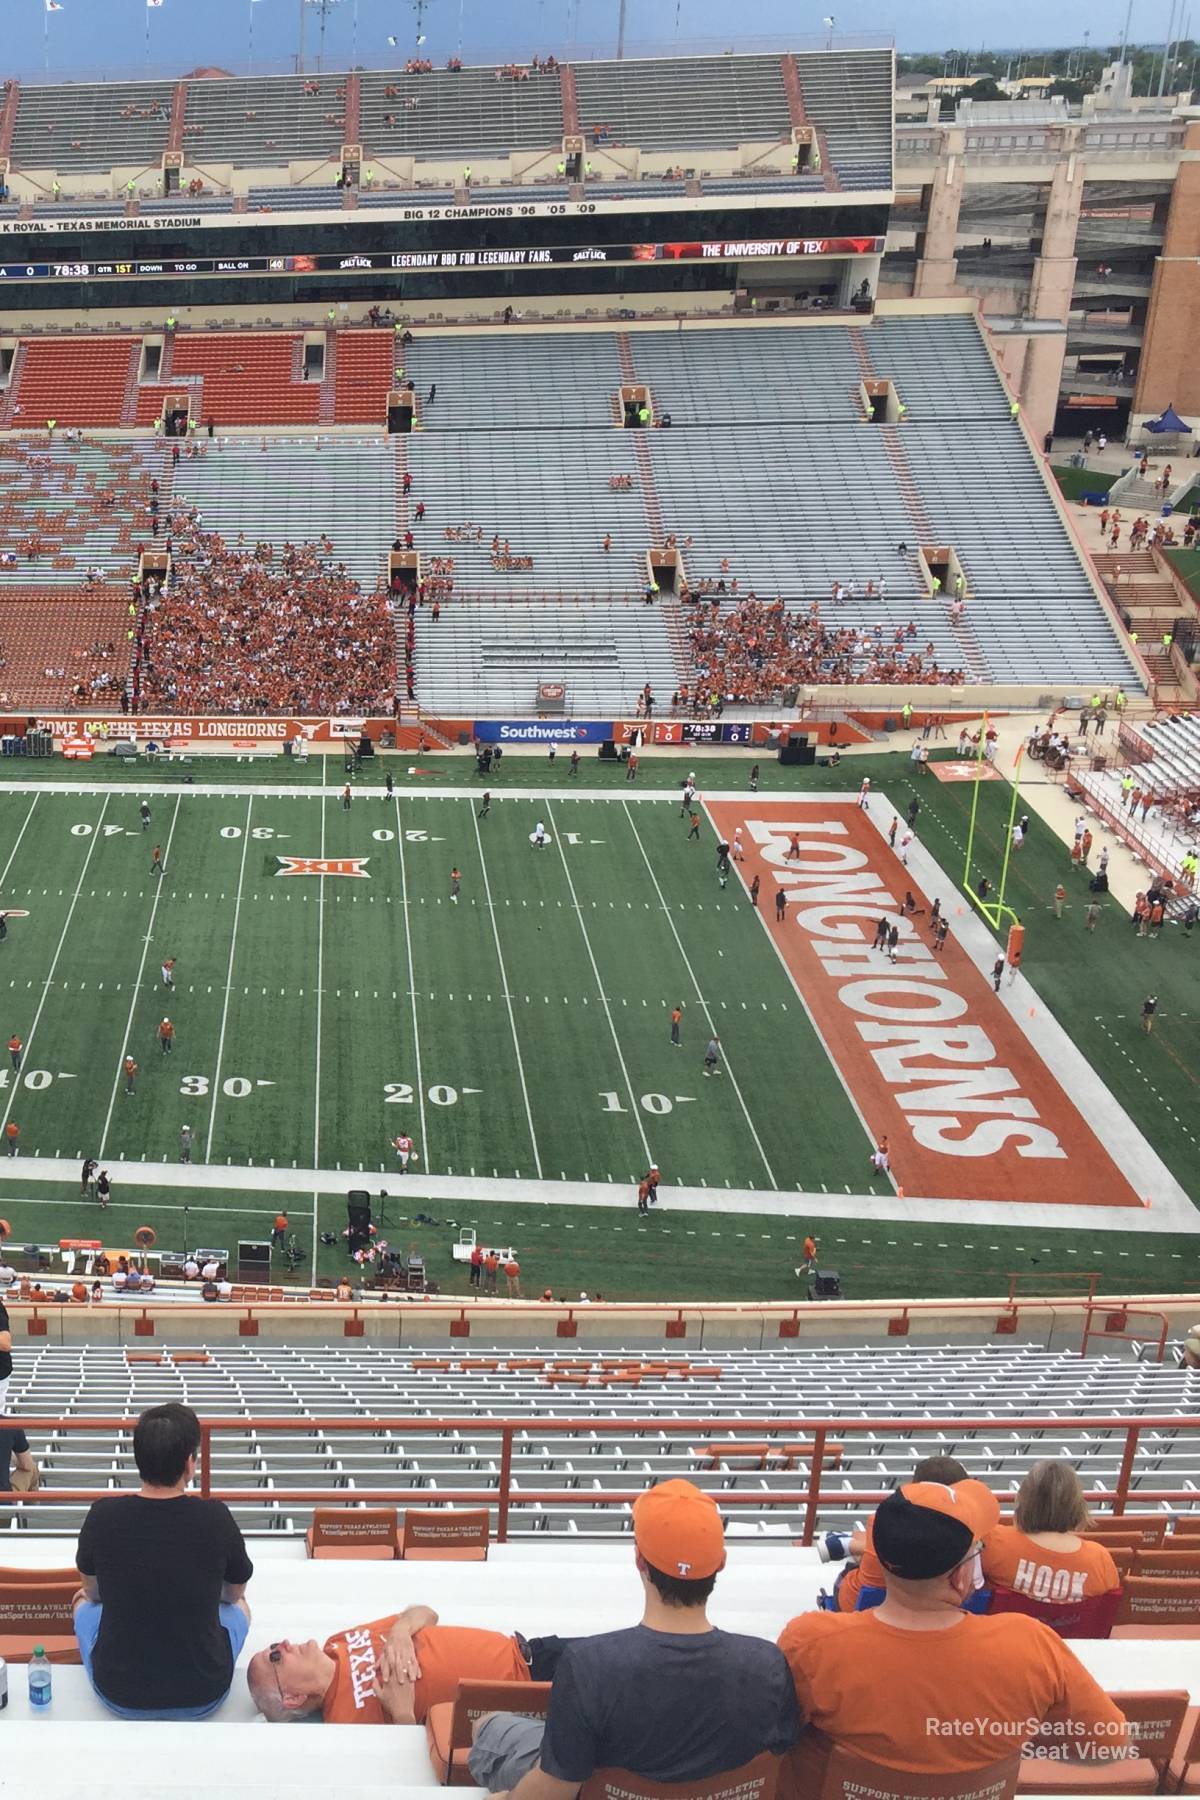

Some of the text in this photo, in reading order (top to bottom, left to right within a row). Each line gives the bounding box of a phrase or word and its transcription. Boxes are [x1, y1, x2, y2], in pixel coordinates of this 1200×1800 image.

[404, 204, 596, 220] BIG 12 CHAMPIONS '96 '05 '09
[3, 224, 11, 232] K
[13, 224, 46, 232] ROYAL
[57, 222, 93, 231] TEXAS
[95, 219, 151, 230] MEMORIAL
[154, 218, 201, 228] STADIUM
[702, 244, 720, 256] THE
[724, 242, 784, 256] UNIVERSITY
[787, 242, 800, 254] OF
[270, 260, 283, 269] 40
[392, 250, 553, 268] LEGENDARY BBQ FOR LEGENDARY FANS.
[26, 267, 34, 276] 0
[53, 265, 90, 276] 78:38
[115, 264, 132, 274] 1ST
[142, 722, 192, 736] TEXAS
[198, 720, 287, 737] LONGHORNS
[500, 726, 576, 739] Southwest
[744, 820, 1068, 1160] LONGHORNS
[180, 1075, 252, 1097] 30
[384, 1083, 458, 1106] 20
[598, 1091, 673, 1114] 10
[677, 1562, 690, 1576] T
[1013, 1558, 1088, 1600] HOOK
[344, 1628, 376, 1710] TEXAS
